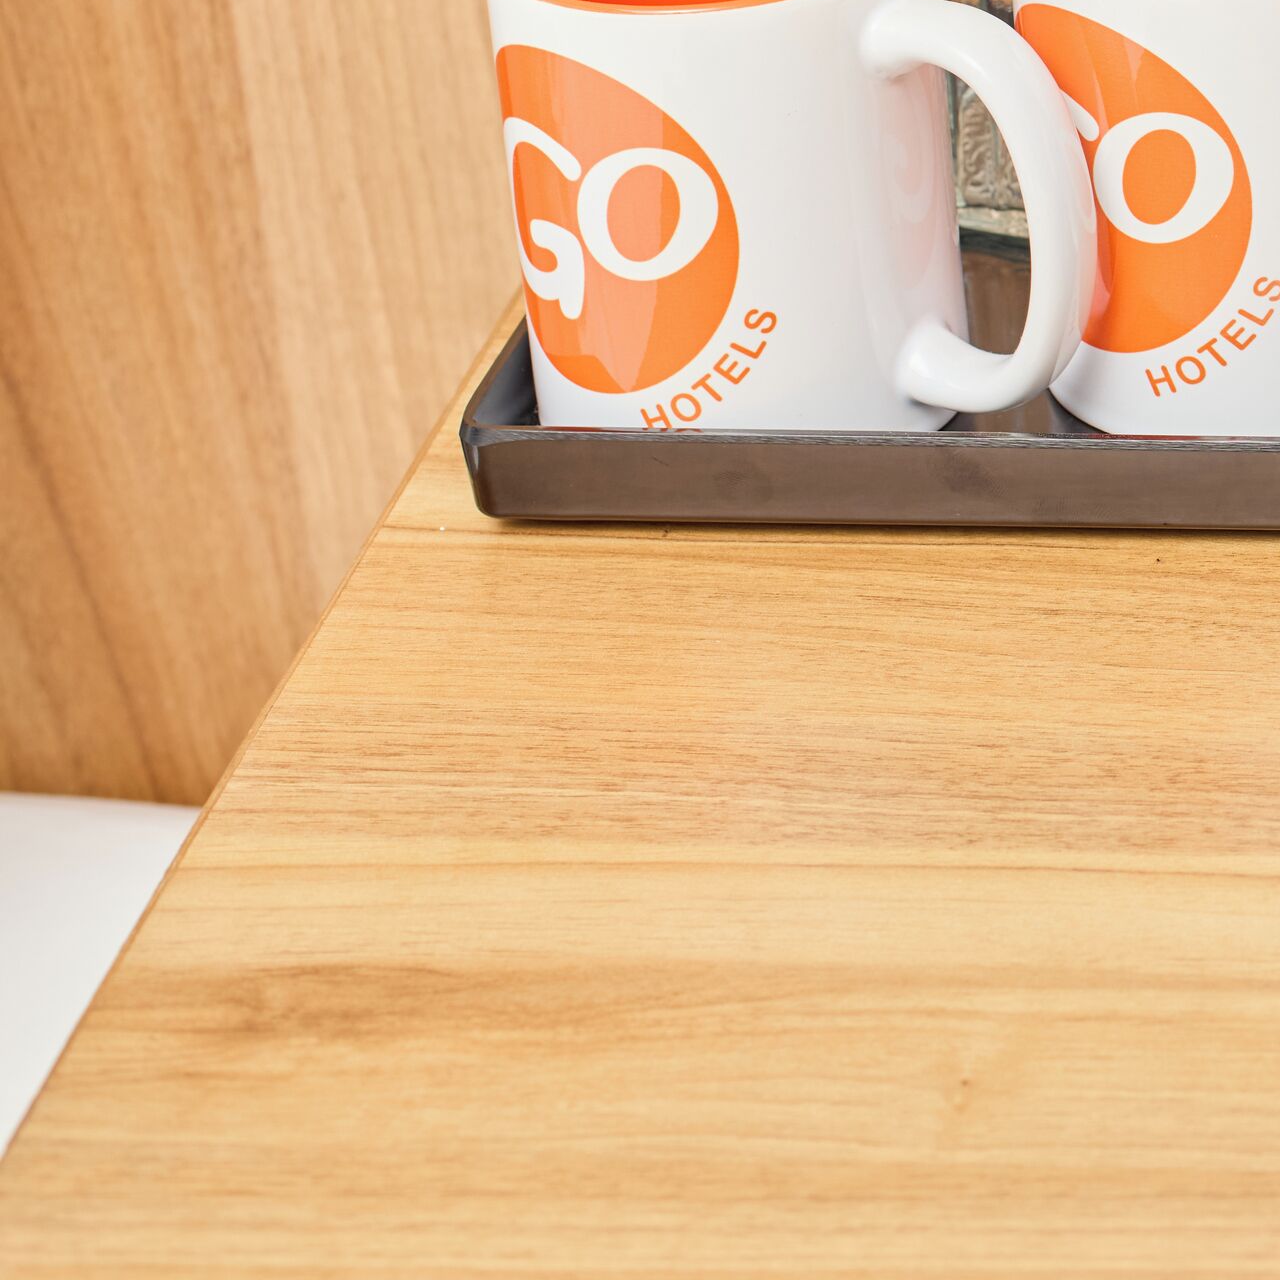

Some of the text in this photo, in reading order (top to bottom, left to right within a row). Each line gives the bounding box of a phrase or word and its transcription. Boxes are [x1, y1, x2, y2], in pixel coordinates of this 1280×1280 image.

[502, 116, 719, 320] GO
[1060, 87, 1235, 244] O
[640, 308, 778, 432] HOTELS
